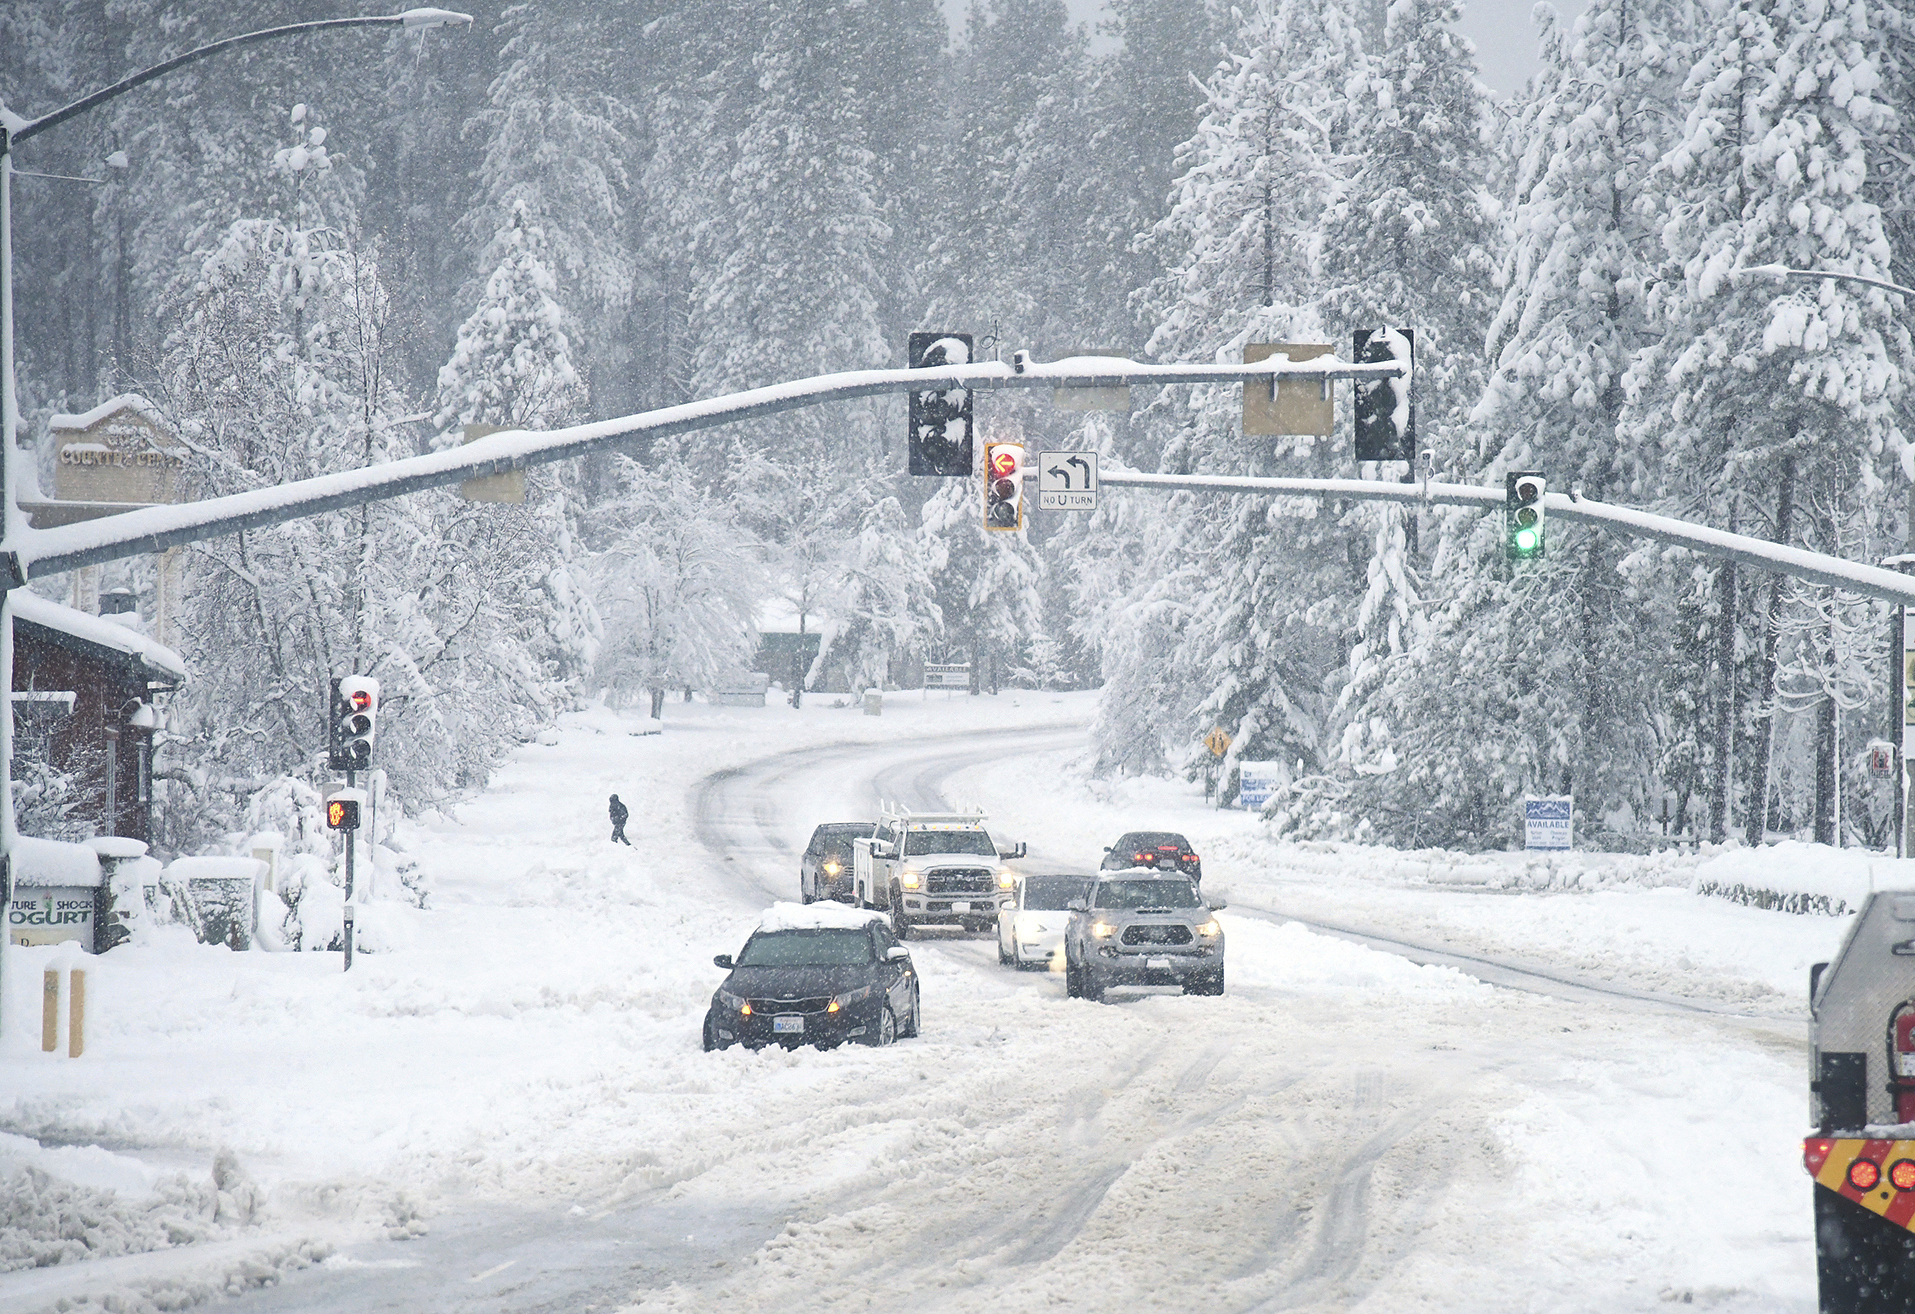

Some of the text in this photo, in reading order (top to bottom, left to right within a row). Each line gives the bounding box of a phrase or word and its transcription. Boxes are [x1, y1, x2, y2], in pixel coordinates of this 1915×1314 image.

[1058, 495, 1067, 505] U
[1070, 496, 1092, 504] TURN
[56, 900, 93, 910] SHOCK
[9, 911, 91, 925] OGURT
